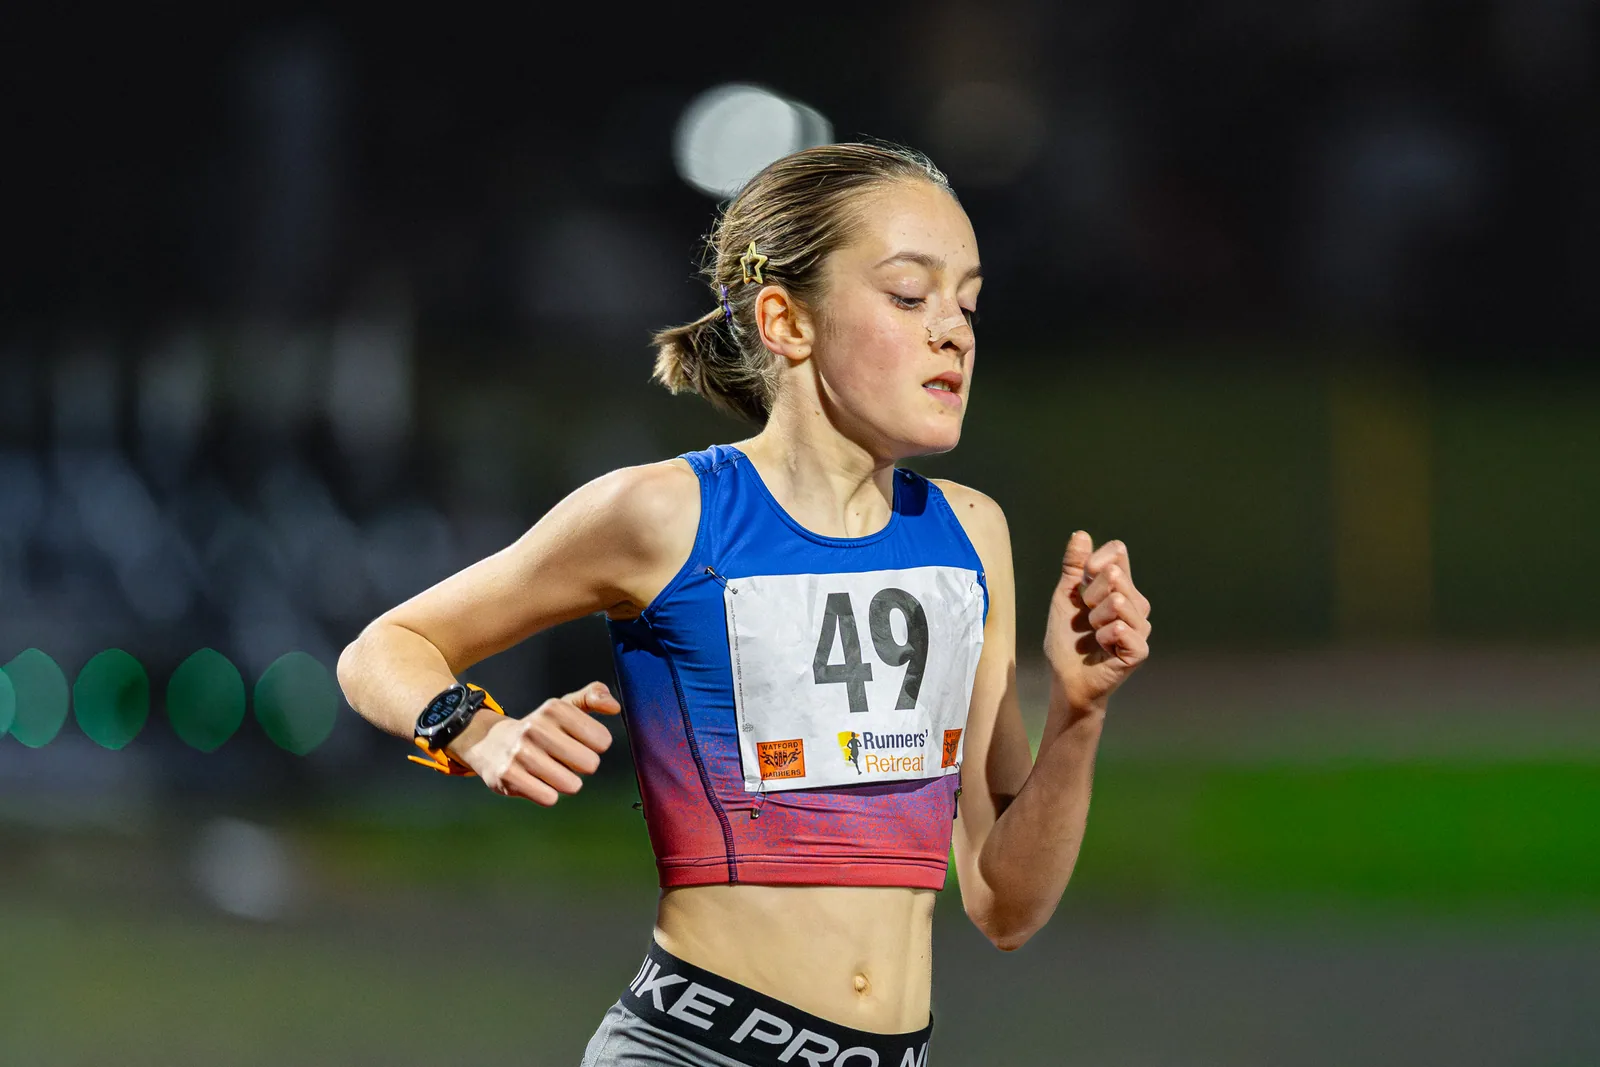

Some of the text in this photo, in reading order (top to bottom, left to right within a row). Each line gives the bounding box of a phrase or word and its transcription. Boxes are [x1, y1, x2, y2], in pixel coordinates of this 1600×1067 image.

[813, 588, 929, 713] 49
[761, 741, 799, 751] WATFORD
[862, 729, 928, 750] Runners'
[762, 768, 802, 778] HARRIERS
[865, 755, 925, 773] Retreat
[629, 953, 735, 1031] IKE
